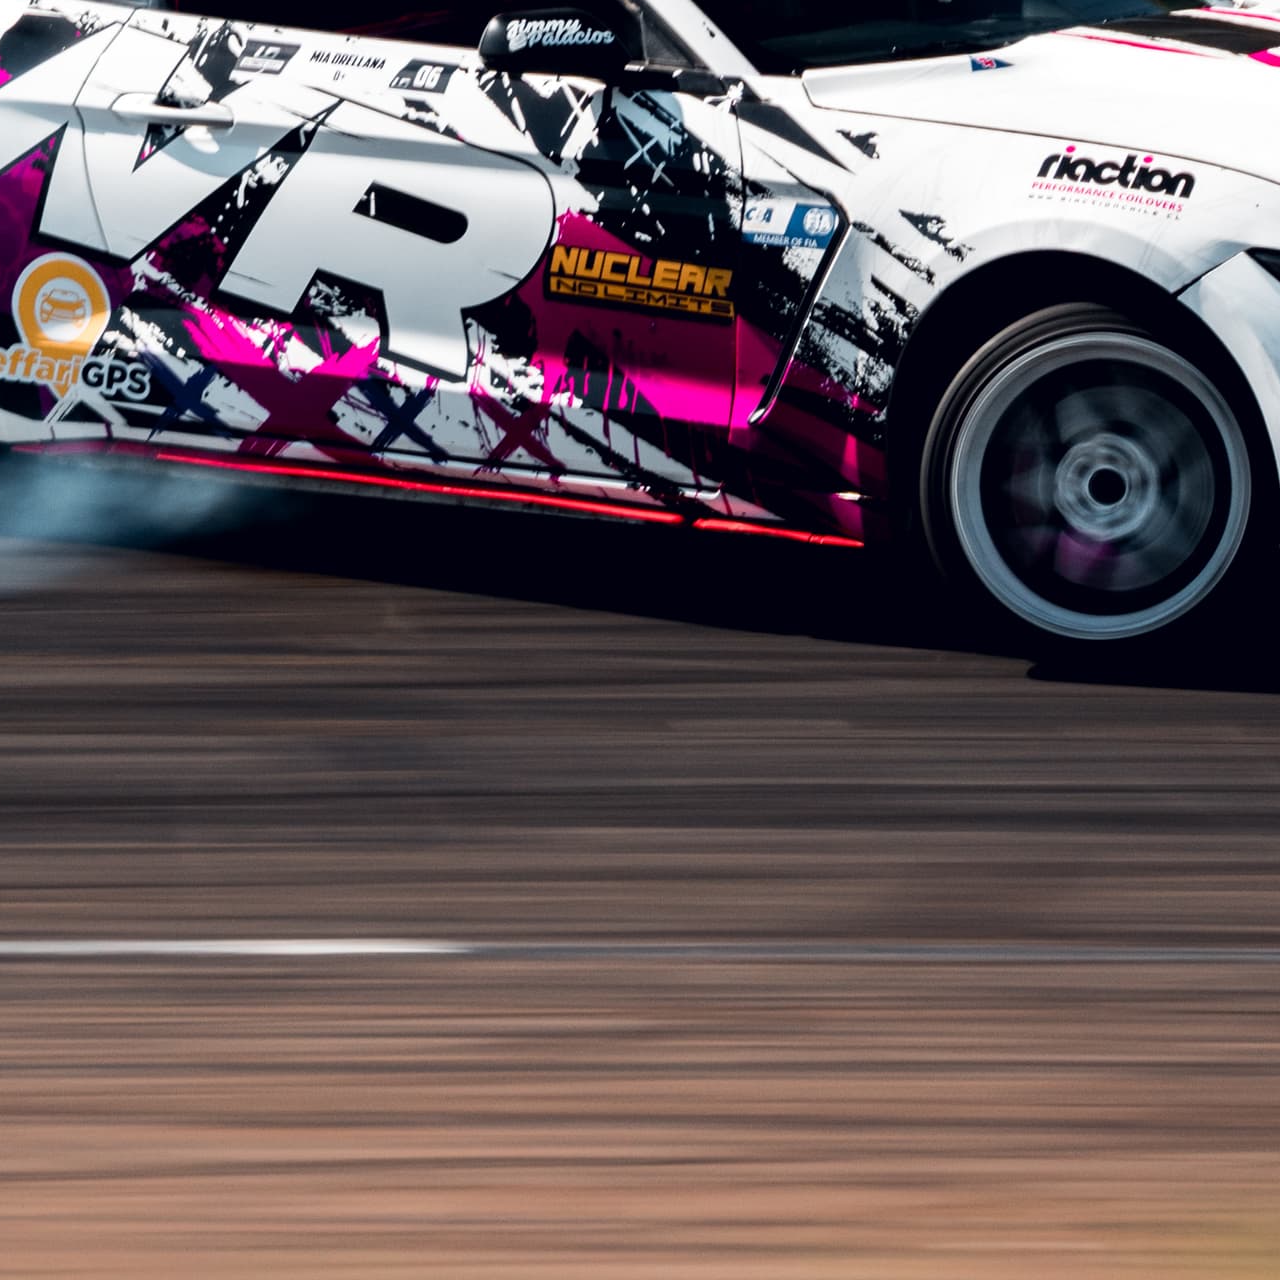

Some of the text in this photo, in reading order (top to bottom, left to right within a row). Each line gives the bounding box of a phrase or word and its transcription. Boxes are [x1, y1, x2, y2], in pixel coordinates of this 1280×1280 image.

[309, 50, 387, 70] MIA ORELLANA
[412, 64, 445, 90] 06
[1036, 145, 1196, 199] riaction
[1031, 181, 1184, 213] PERFORMANCE COILOVERS
[549, 245, 734, 297] NUCLEAR
[556, 278, 734, 316] NO LIMITS
